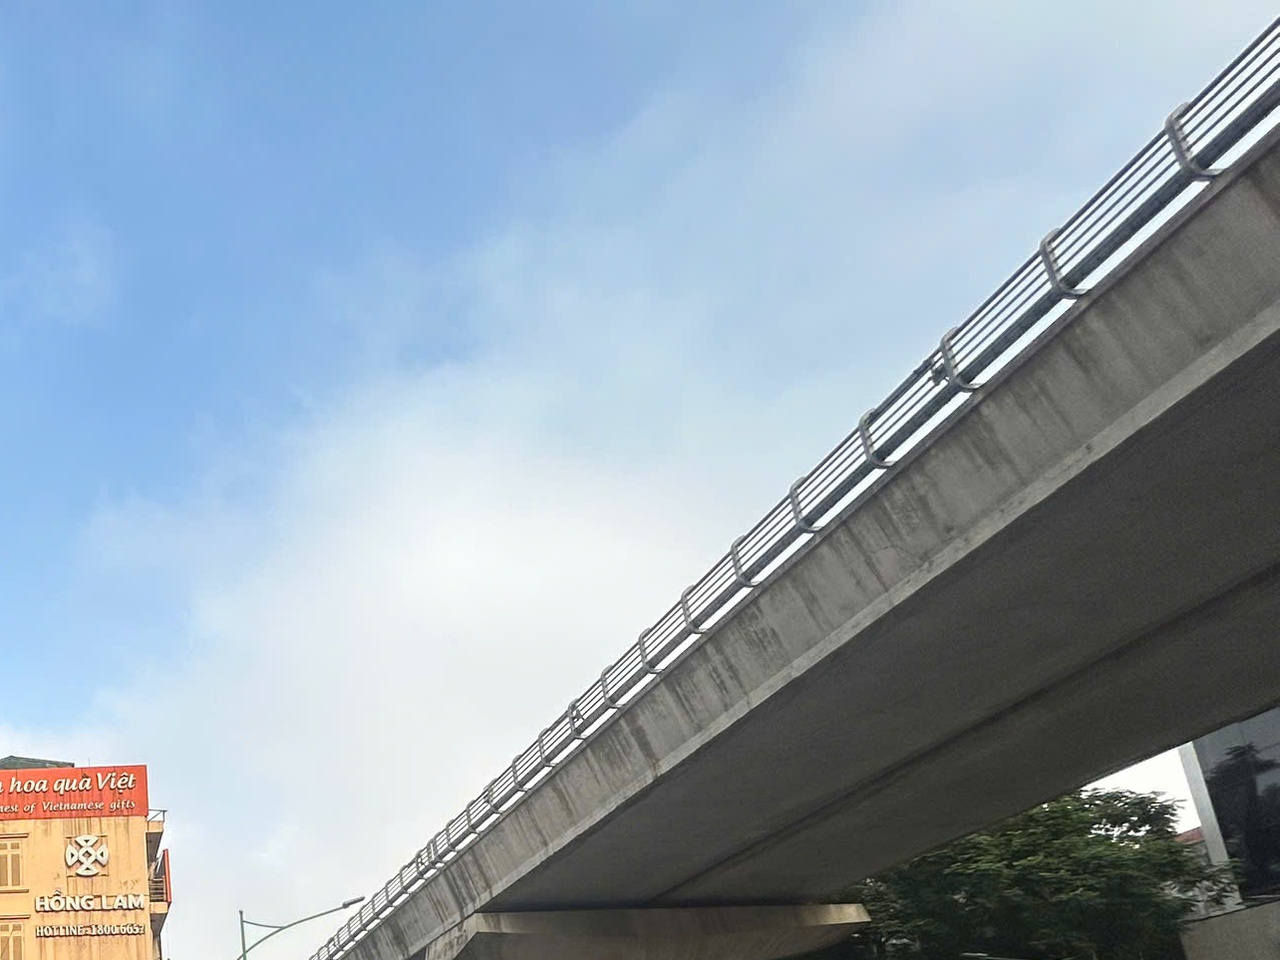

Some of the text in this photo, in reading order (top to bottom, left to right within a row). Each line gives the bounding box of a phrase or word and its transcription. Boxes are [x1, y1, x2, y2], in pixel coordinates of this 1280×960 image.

[9, 776, 48, 795] hoa
[53, 773, 93, 796] quà
[96, 771, 137, 795] Việt
[23, 802, 37, 814] of
[42, 801, 105, 812] Vietnamese
[109, 799, 137, 812] gifts
[35, 889, 145, 912] HỒNG LAM
